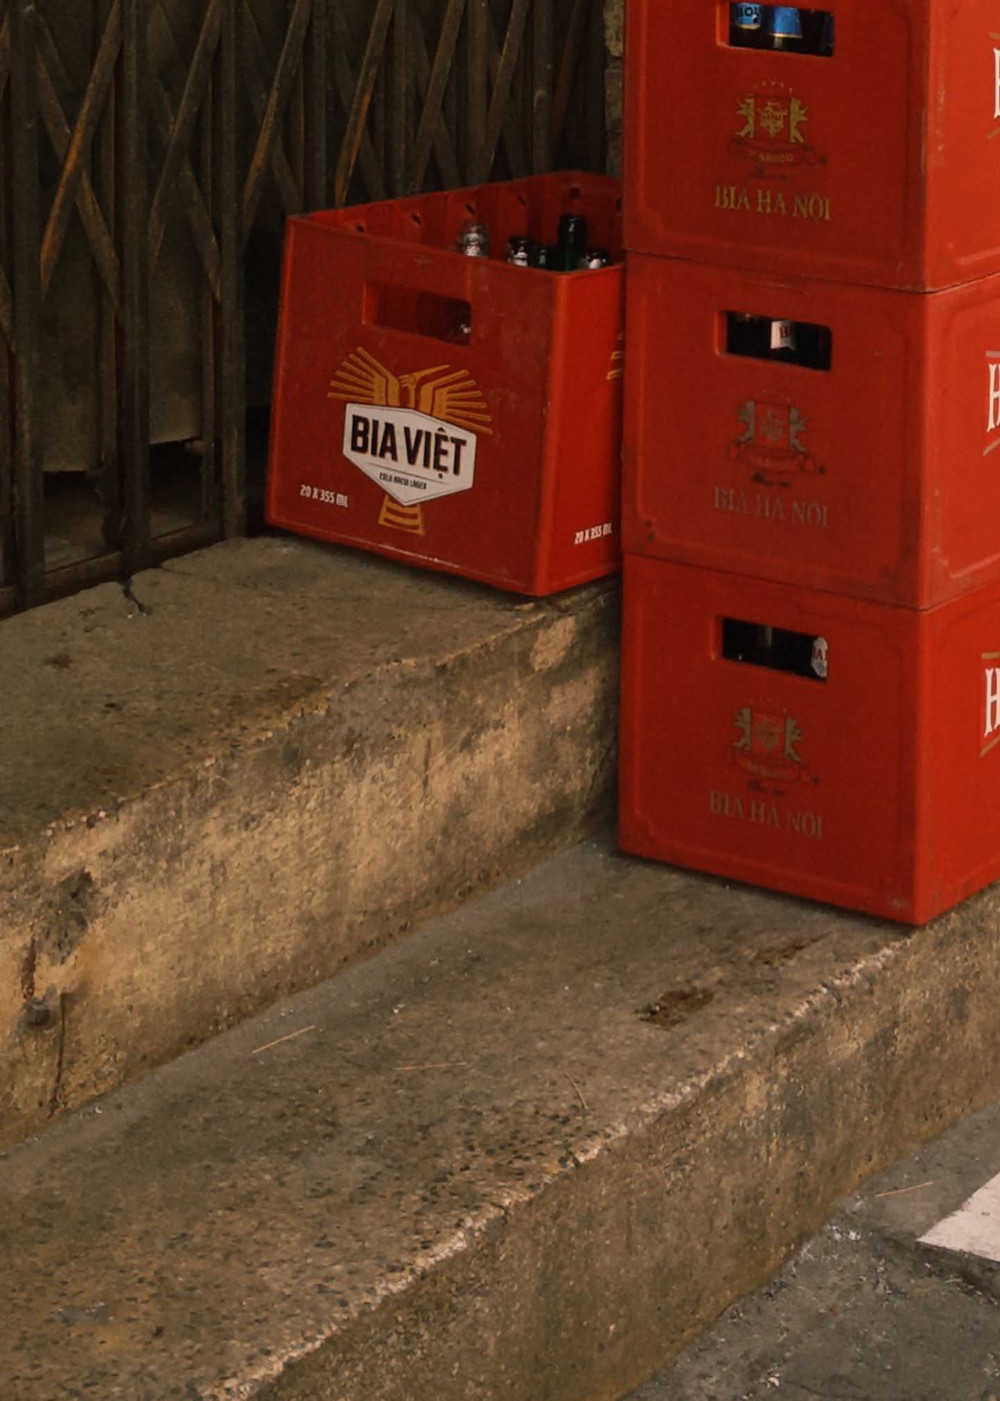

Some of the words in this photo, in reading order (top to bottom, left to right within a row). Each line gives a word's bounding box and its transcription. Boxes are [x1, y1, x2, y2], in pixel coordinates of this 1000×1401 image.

[714, 184, 750, 211] BIA
[350, 413, 399, 462] BIA
[403, 426, 467, 480] VIỆT
[300, 484, 312, 498] 20
[312, 487, 319, 499] X
[319, 489, 335, 504] 355
[713, 485, 750, 514] BIA
[709, 789, 746, 820] BIA
